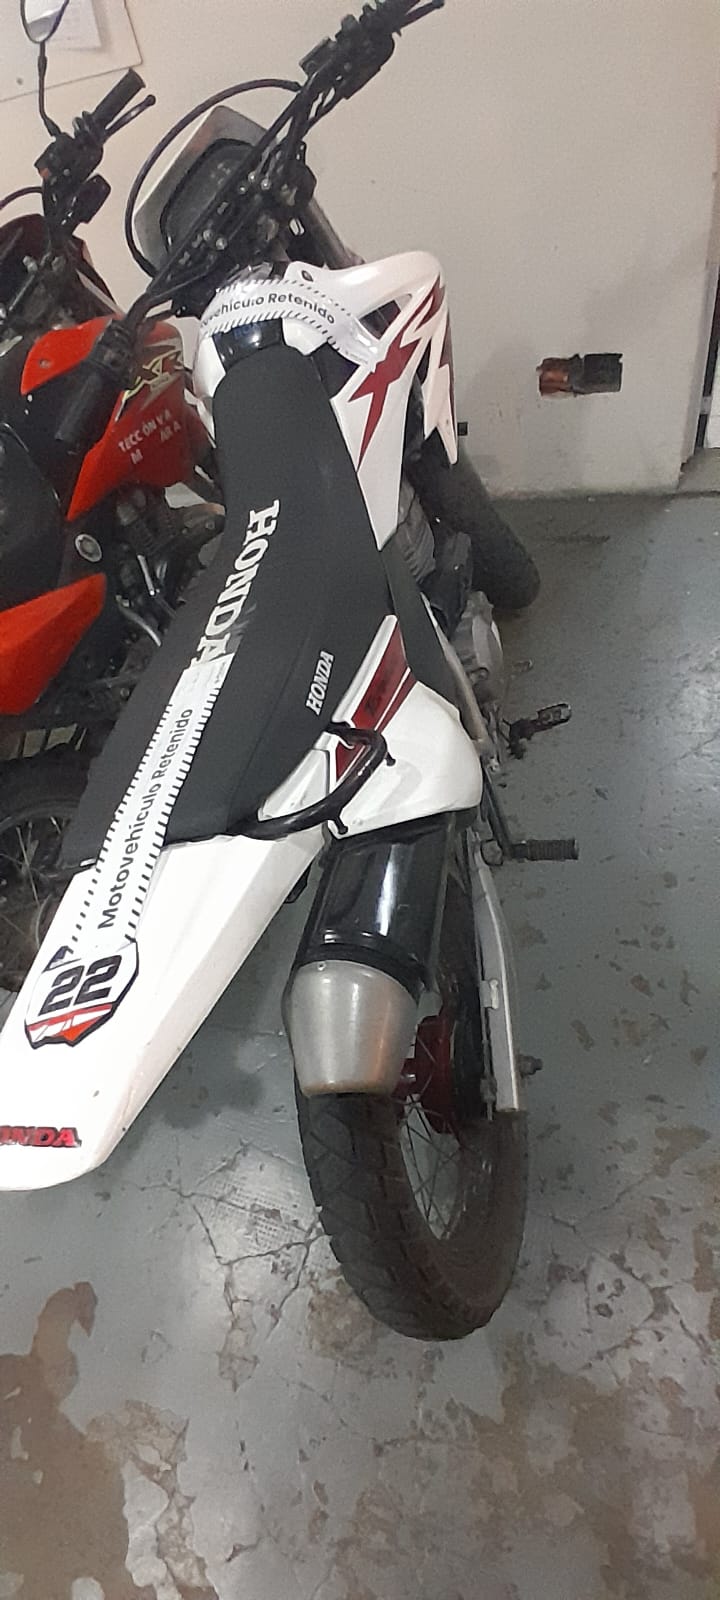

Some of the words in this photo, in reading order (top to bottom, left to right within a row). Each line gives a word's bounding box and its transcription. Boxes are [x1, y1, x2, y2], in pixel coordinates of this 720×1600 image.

[268, 293, 335, 324] Retenido
[190, 499, 280, 668] HONDA
[305, 650, 335, 716] HONDA
[97, 783, 162, 929] Motovehículo
[152, 708, 193, 779] Retenido
[38, 955, 123, 1017] 22
